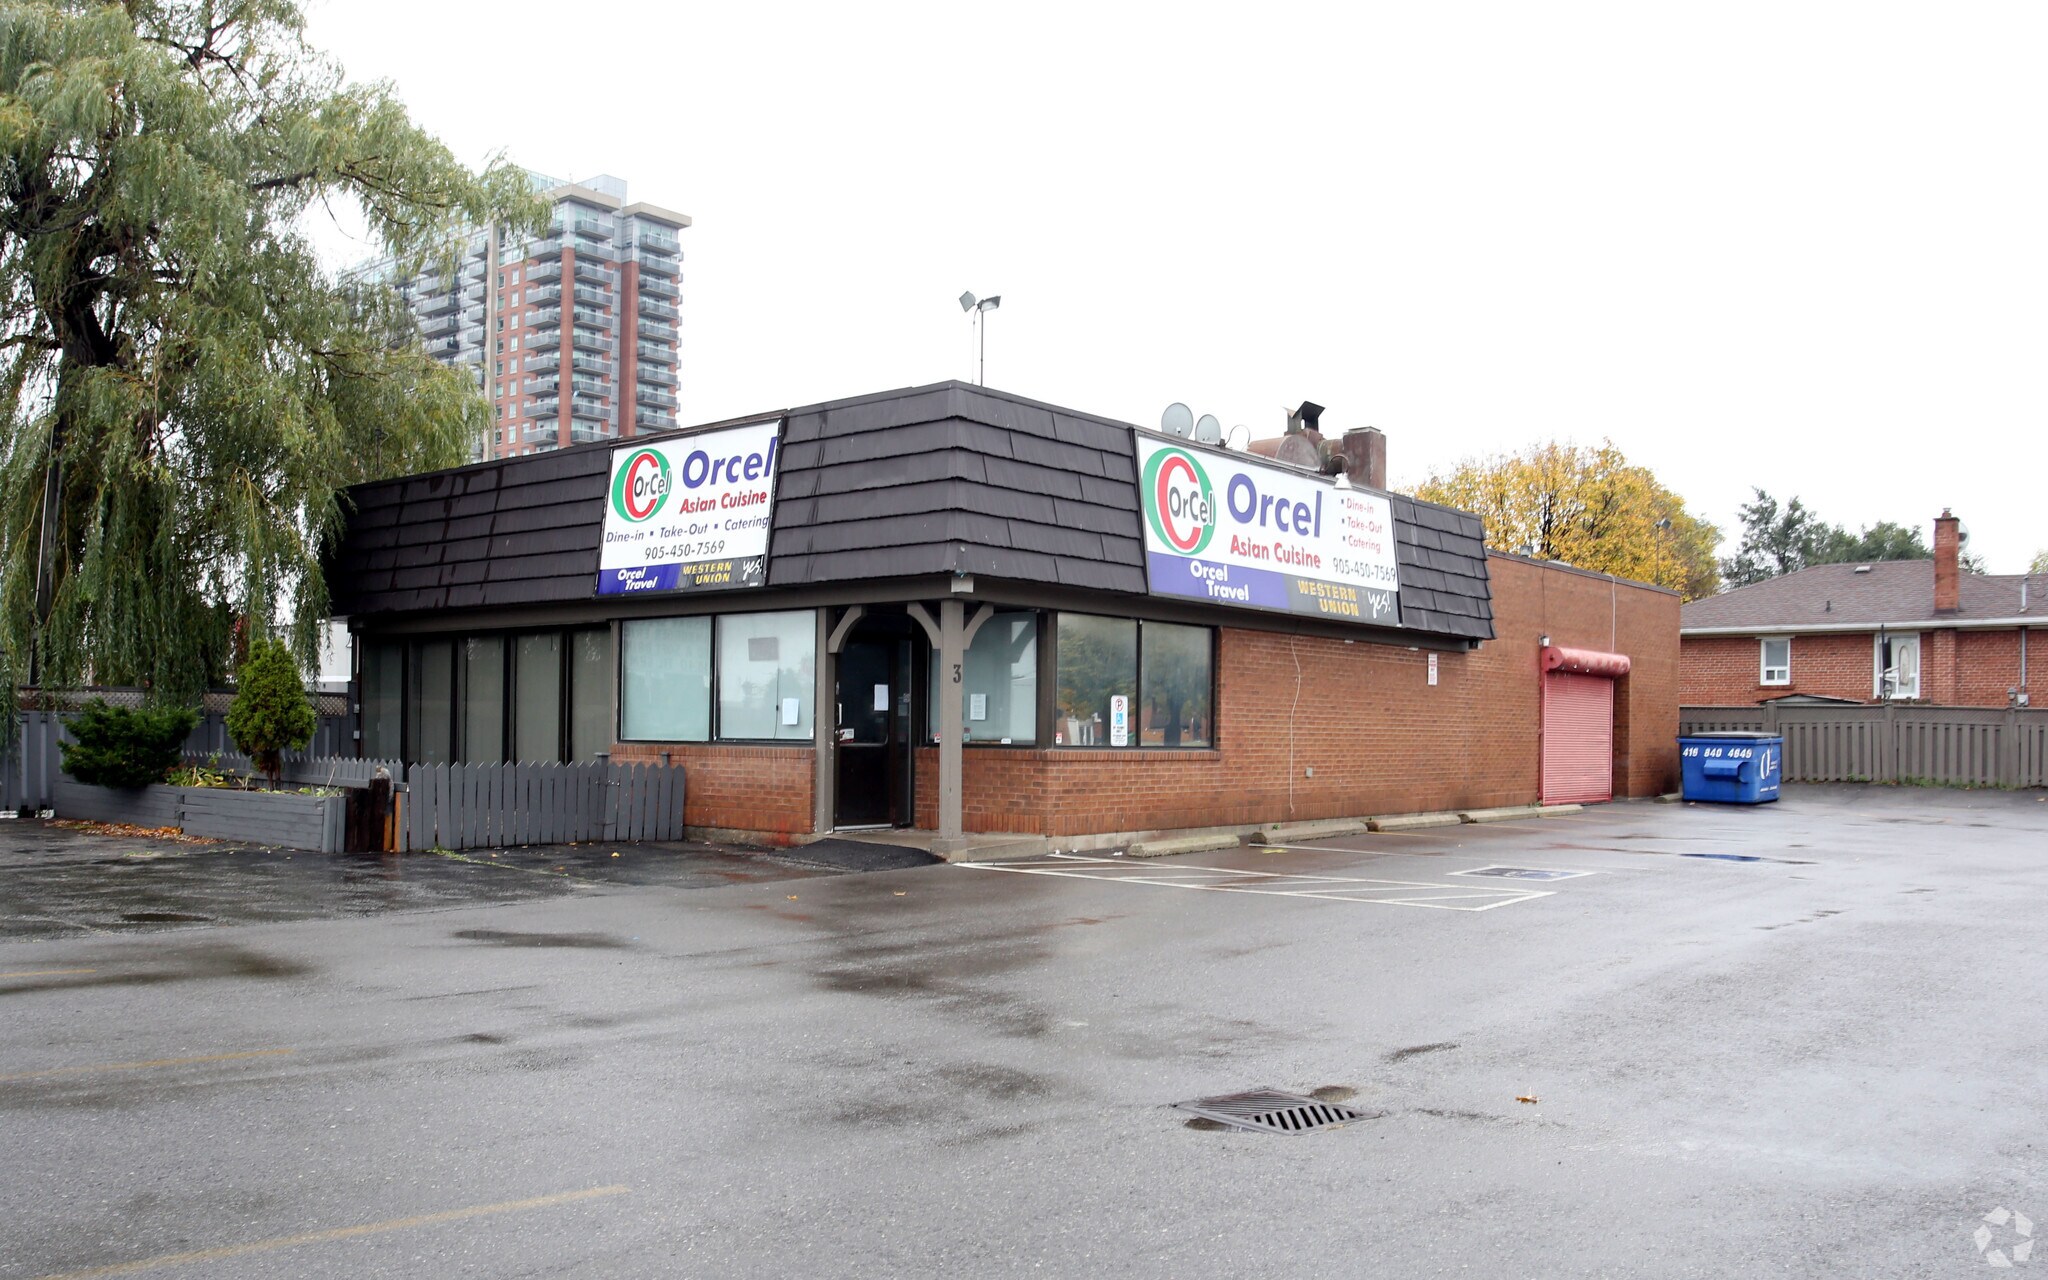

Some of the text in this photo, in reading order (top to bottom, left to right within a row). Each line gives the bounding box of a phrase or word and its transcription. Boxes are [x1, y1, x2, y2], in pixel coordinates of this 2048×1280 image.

[682, 437, 778, 489] Orcel
[634, 470, 670, 498] OrCel
[679, 491, 767, 514] Asian Cuisine
[1169, 486, 1214, 524] OrCel
[1227, 473, 1322, 538] Orcel
[1347, 498, 1374, 515] Dine-in
[606, 516, 769, 543] Dine-in Take-Out Catering
[1347, 516, 1383, 534] Take-Out
[645, 540, 725, 560] 905-450-7569
[1230, 535, 1321, 569] Asian Cuisine
[1348, 535, 1381, 554] Catering
[617, 567, 646, 581] Orcel
[682, 562, 732, 575] WESTERN
[695, 573, 730, 585] UNION
[1190, 560, 1229, 582] Orcel
[1333, 557, 1396, 582] 905-450-7569
[624, 577, 658, 590] Travel
[1206, 579, 1249, 601] Travel
[1297, 580, 1357, 602] WESTERN
[1319, 598, 1359, 617] UNION
[953, 664, 961, 683] 3
